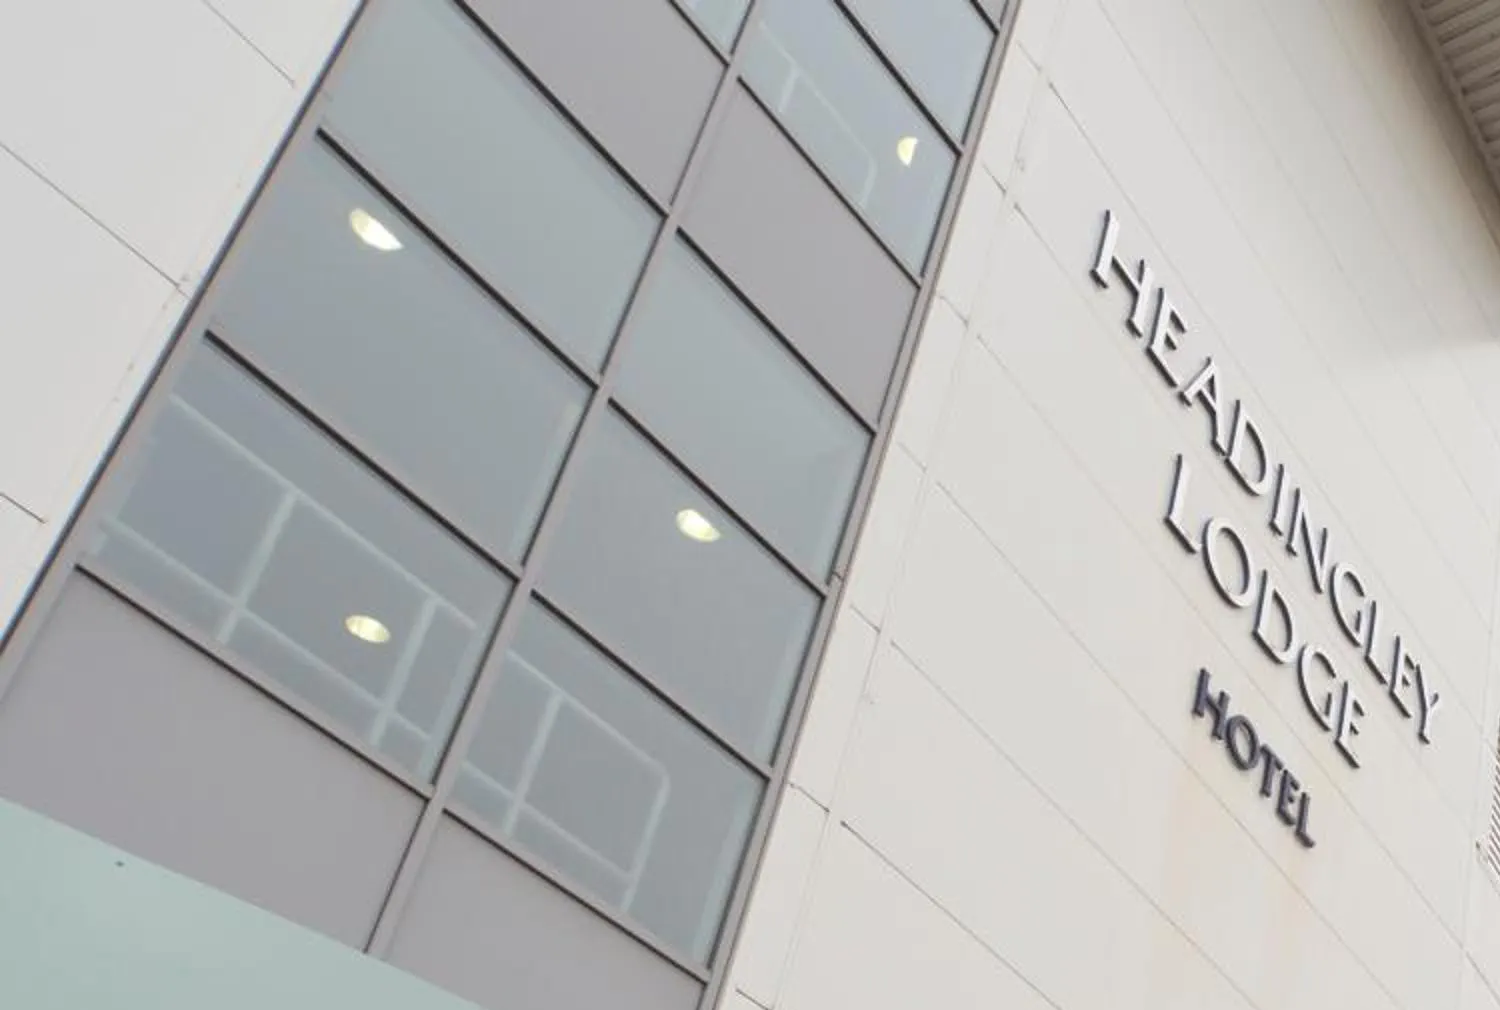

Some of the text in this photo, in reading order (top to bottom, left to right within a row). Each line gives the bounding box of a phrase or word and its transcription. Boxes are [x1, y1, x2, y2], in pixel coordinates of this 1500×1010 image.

[1090, 209, 1439, 744] HEADINGLEY
[1164, 453, 1366, 768] LODGE
[1191, 667, 1316, 848] HOTEL
